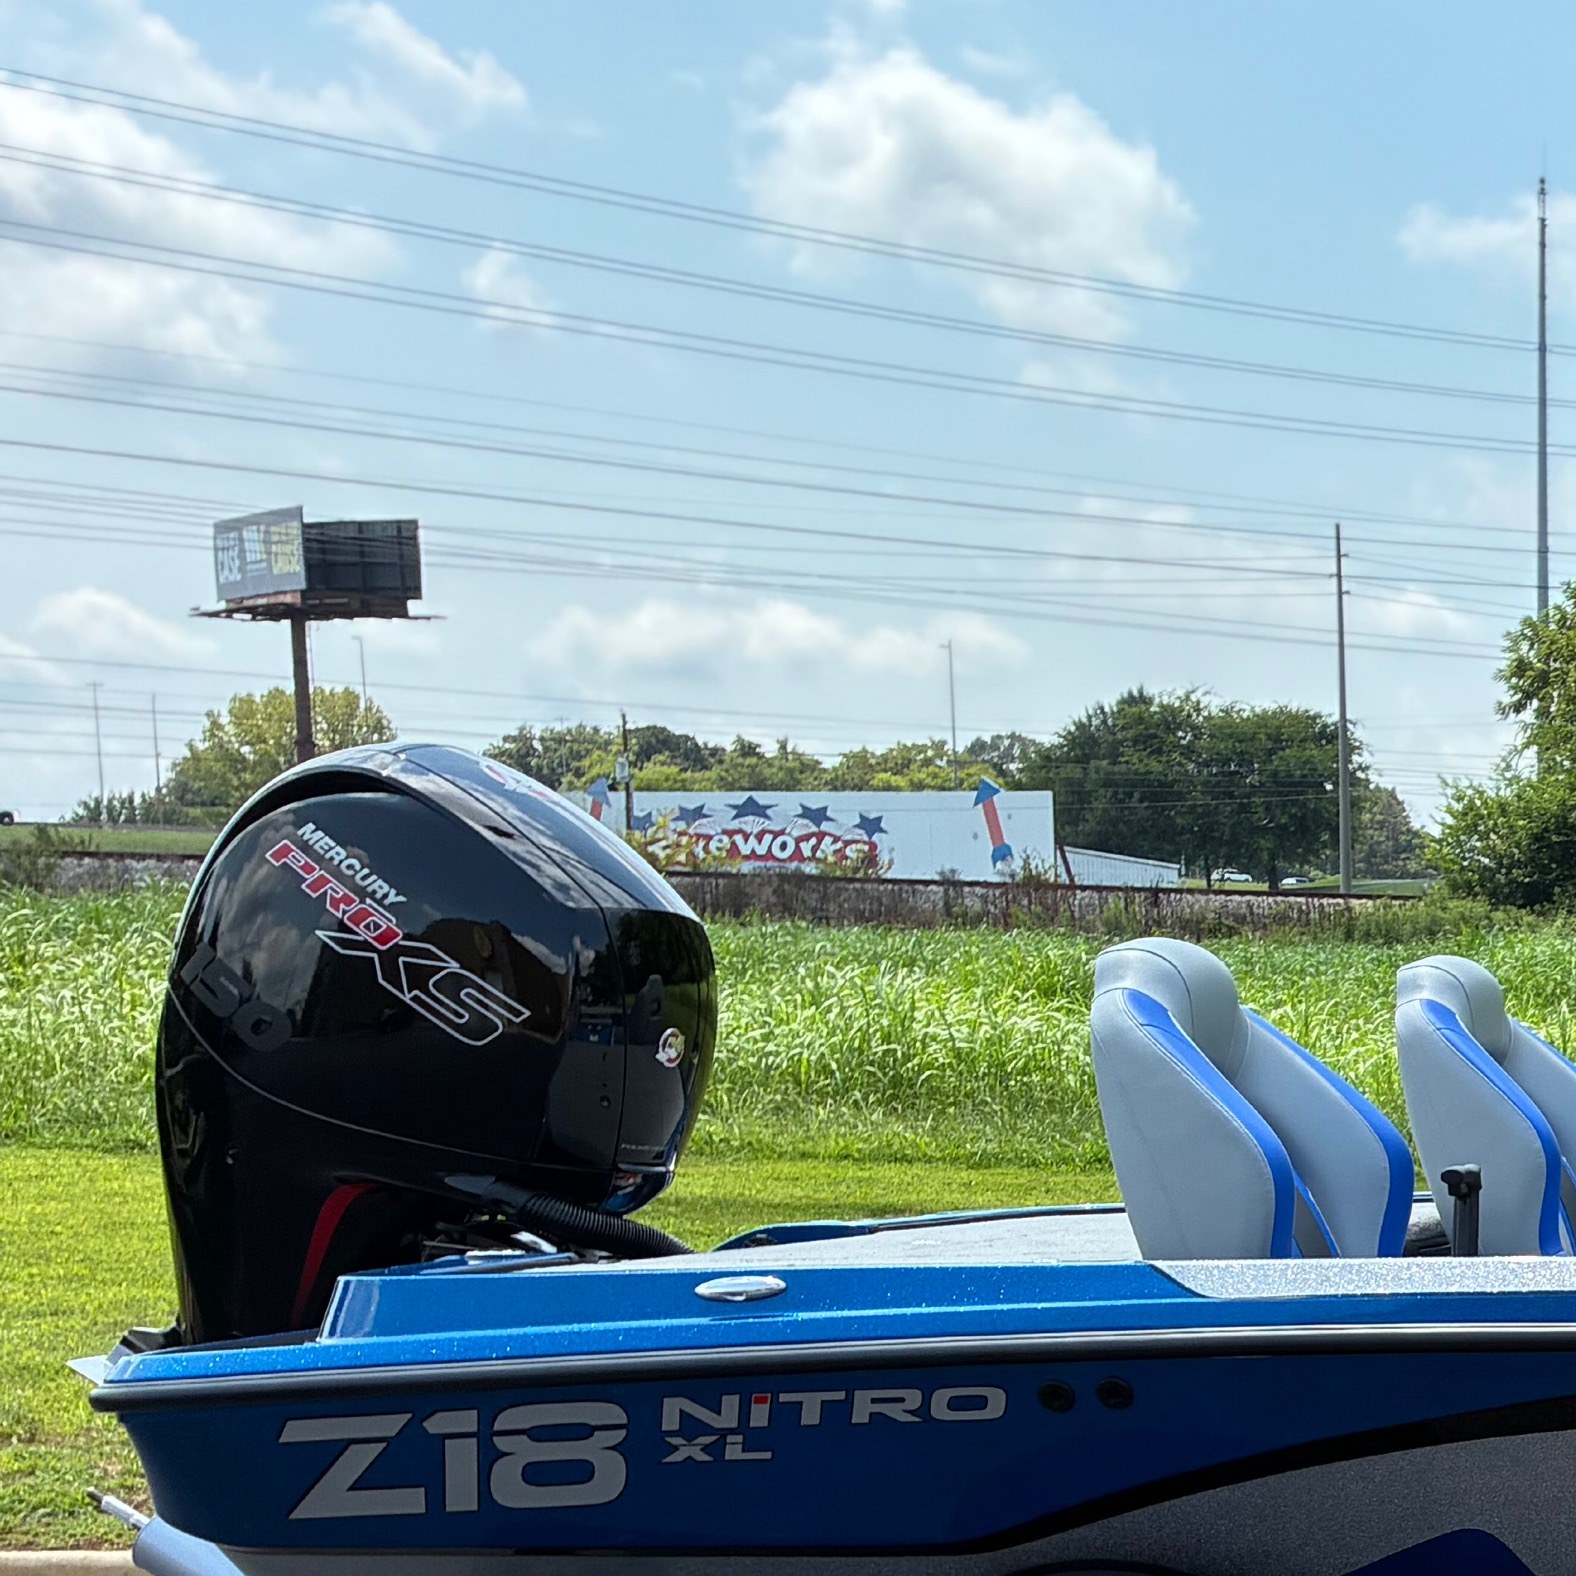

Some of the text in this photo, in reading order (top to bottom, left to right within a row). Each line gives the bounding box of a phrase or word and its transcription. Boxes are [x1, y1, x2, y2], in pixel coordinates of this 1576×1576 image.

[264, 838, 404, 951] PRO
[297, 821, 408, 907] MERCURY
[314, 896, 532, 1047] XS
[278, 1400, 629, 1521] Z18
[660, 1433, 774, 1464] XL
